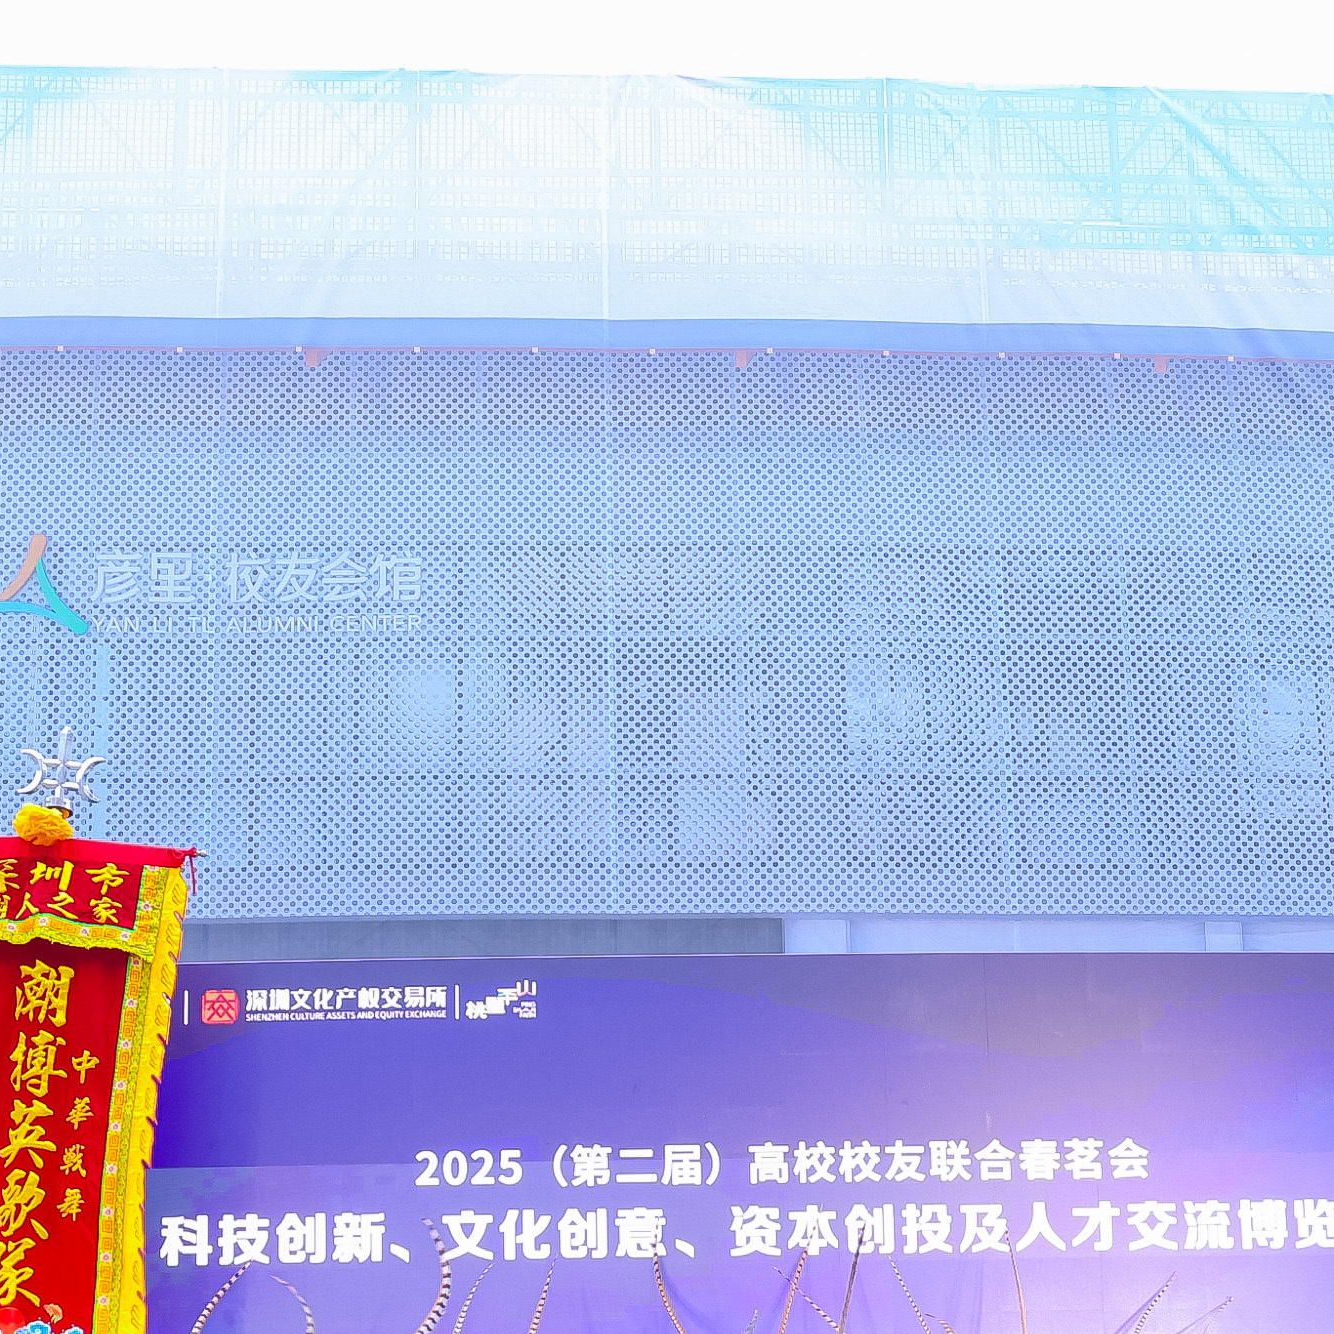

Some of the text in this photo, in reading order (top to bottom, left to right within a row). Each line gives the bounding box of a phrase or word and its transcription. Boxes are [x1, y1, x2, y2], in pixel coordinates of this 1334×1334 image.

[92, 616, 140, 634] YAN
[226, 615, 319, 634] ALUMNI
[330, 614, 423, 633] CENTER
[245, 986, 448, 1012] 深圳文化产权交易所
[290, 1011, 325, 1021] CULTURE
[325, 1010, 357, 1020] ASSETS
[404, 1009, 447, 1019] EXCHANGE
